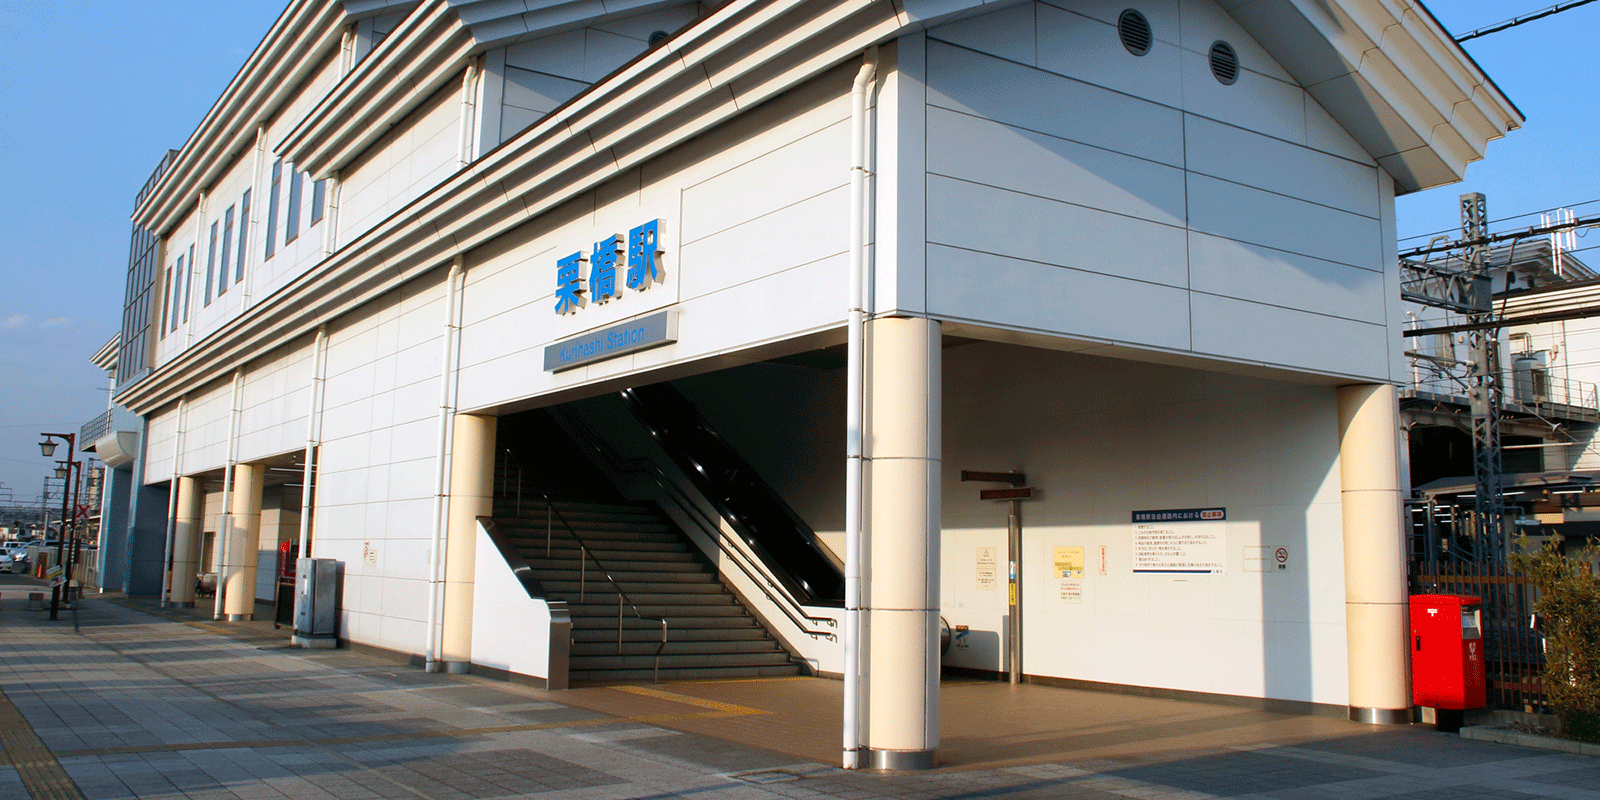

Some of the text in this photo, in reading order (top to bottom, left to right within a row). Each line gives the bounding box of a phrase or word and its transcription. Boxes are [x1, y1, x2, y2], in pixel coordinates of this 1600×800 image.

[554, 218, 665, 315] 栗橋駅
[560, 326, 645, 362] Kurihashi Station
